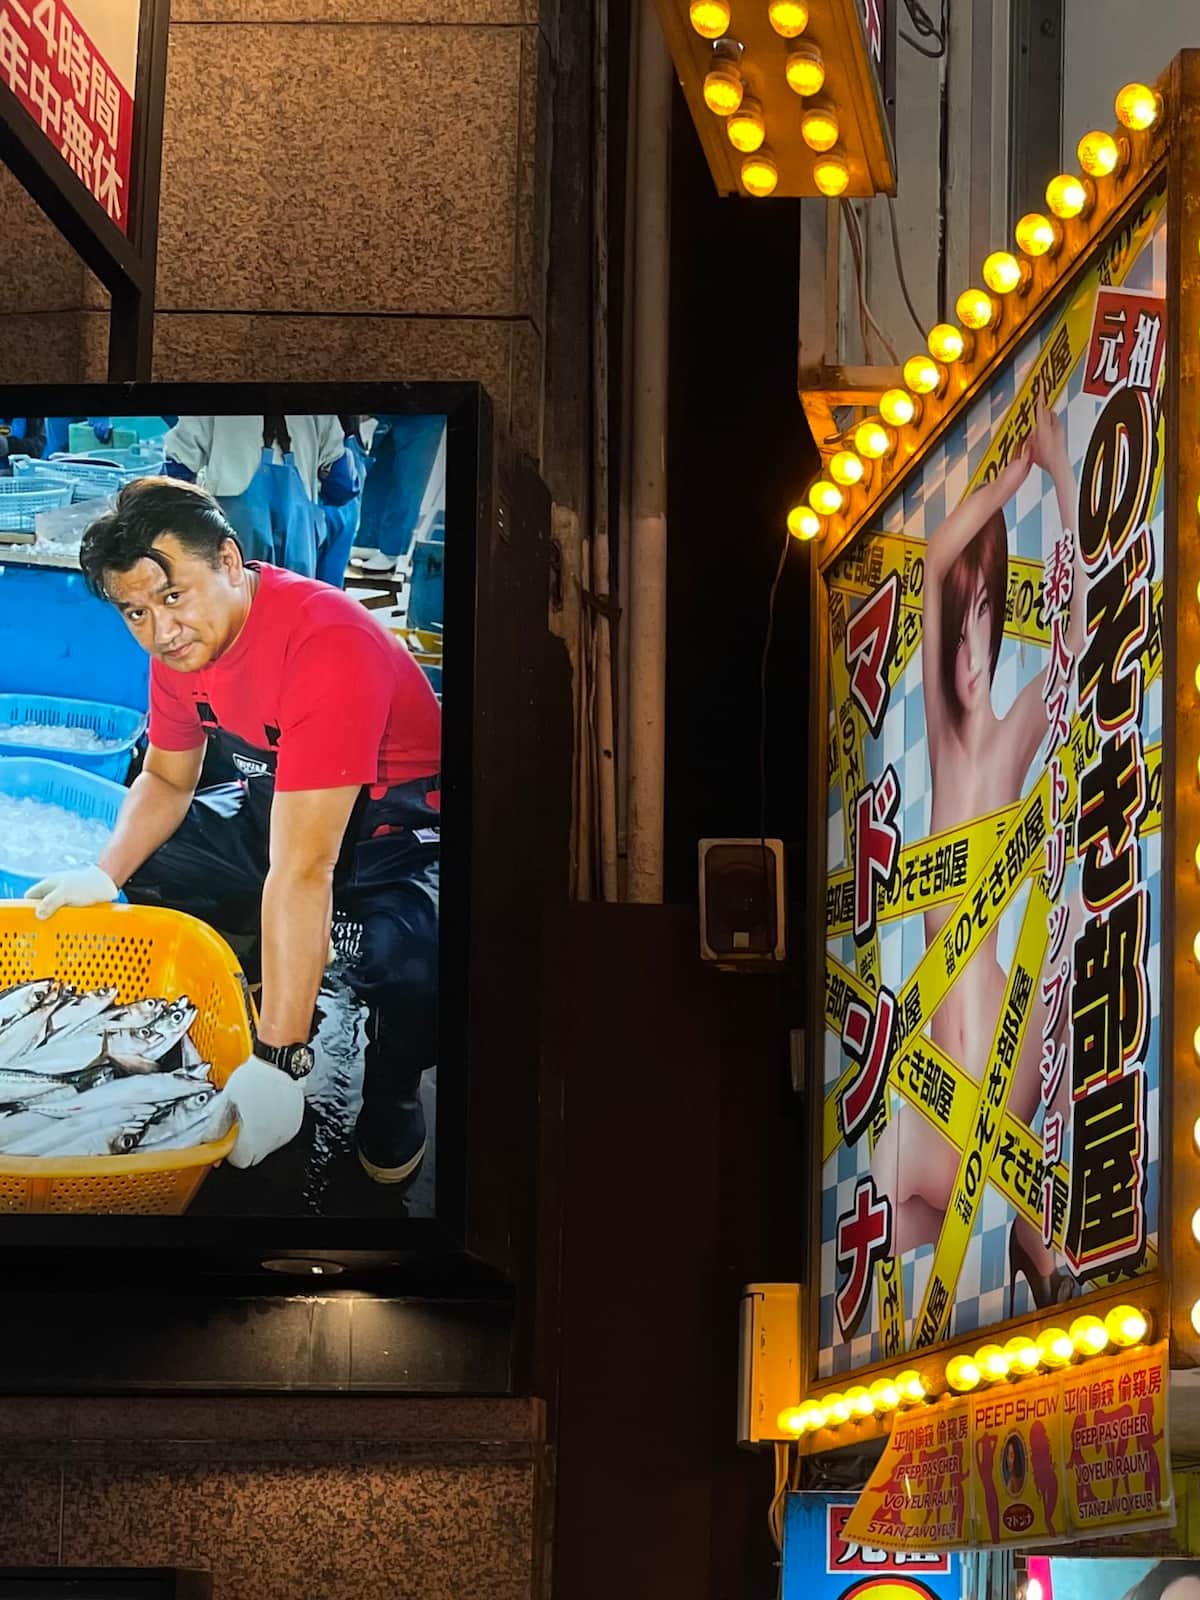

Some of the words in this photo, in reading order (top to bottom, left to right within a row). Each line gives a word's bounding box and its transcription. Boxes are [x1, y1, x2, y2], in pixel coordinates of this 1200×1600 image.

[0, 9, 122, 219] 年中無休
[1092, 309, 1160, 388] 元祖
[942, 796, 1047, 978] 元祖のぞき部屋
[1041, 530, 1075, 1248] 素人ストリップショー
[1066, 388, 1156, 1278] のぞき部屋
[836, 570, 900, 1343] マドンナ
[955, 966, 1033, 1225] 元祖のぞき部屋
[975, 1404, 1014, 1430] PEEP
[1015, 1395, 1059, 1423] SHOW
[1074, 1423, 1099, 1450] PEEP
[1098, 1419, 1121, 1444] PAS
[1121, 1413, 1149, 1439] CHER
[1076, 1461, 1115, 1485] VOYEUR
[1115, 1453, 1149, 1477] RAUM
[884, 1491, 930, 1510] VOYEUR
[1079, 1496, 1117, 1520] STANZA
[1117, 1491, 1153, 1515] VOYEUR
